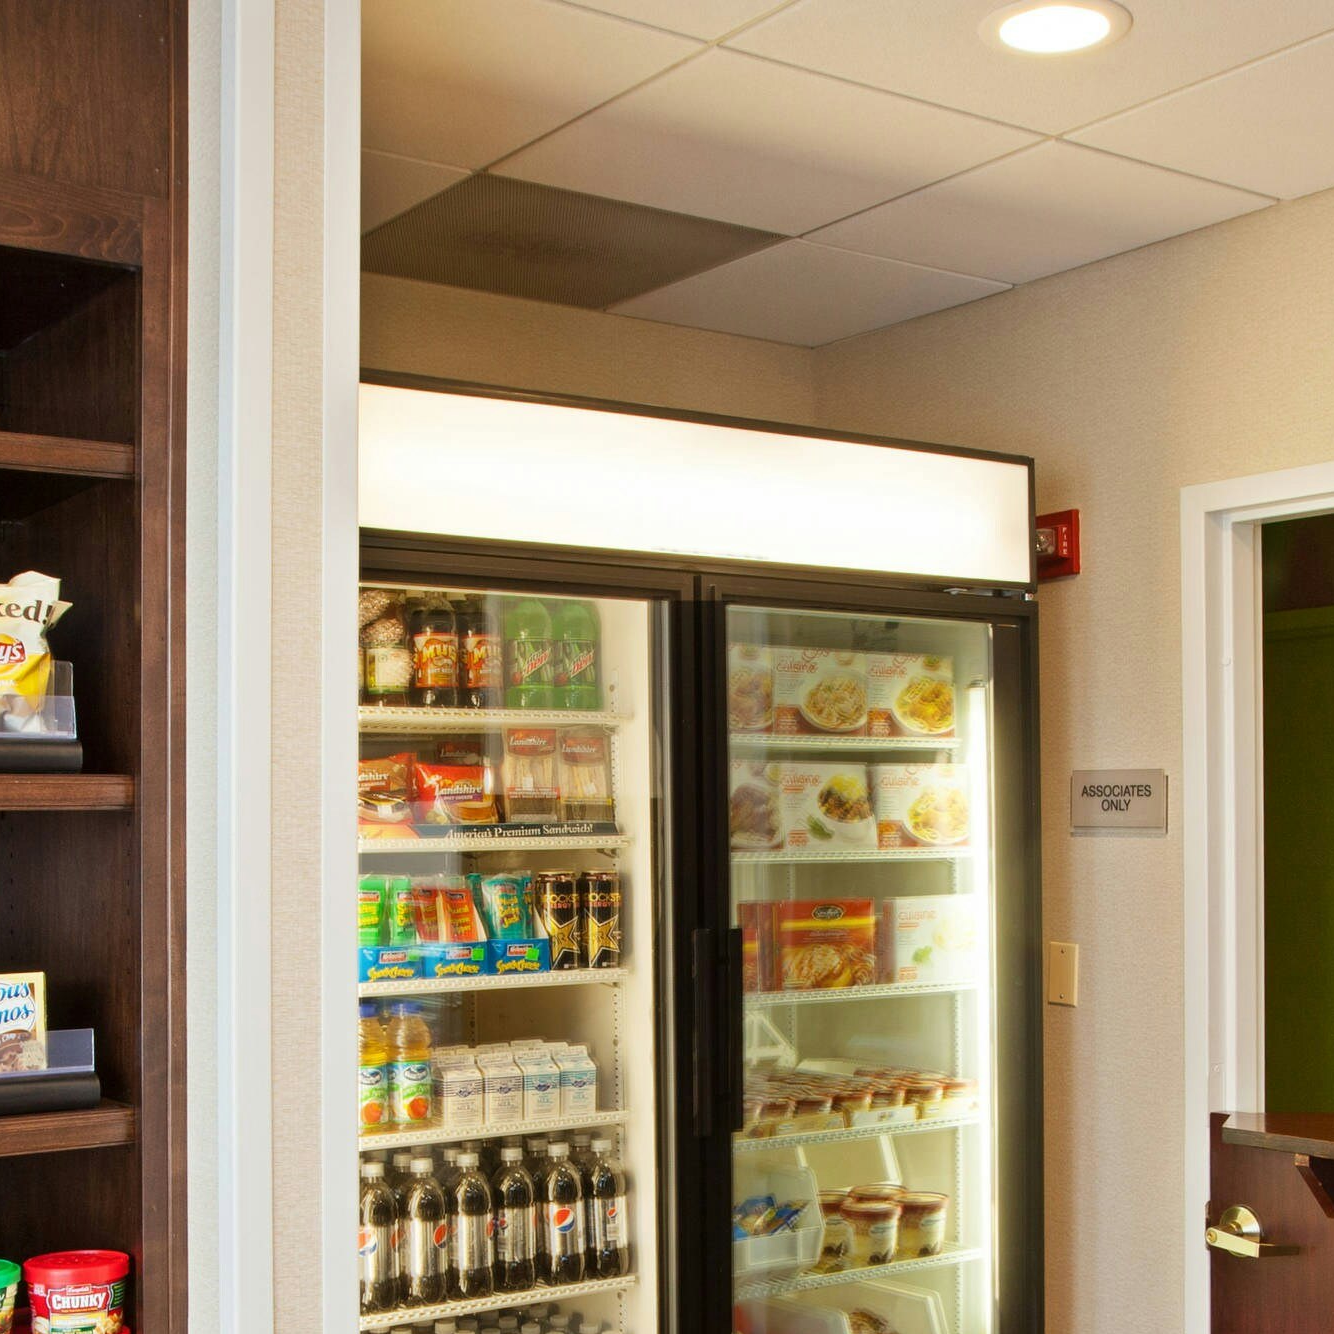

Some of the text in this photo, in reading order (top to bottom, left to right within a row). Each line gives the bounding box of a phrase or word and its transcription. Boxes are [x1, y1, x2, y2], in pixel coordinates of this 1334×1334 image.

[1081, 784, 1152, 798] ASSOCIATES
[1101, 798, 1131, 812] ONLY
[494, 826, 542, 838] Premium
[51, 1292, 106, 1310] CHUNKY
